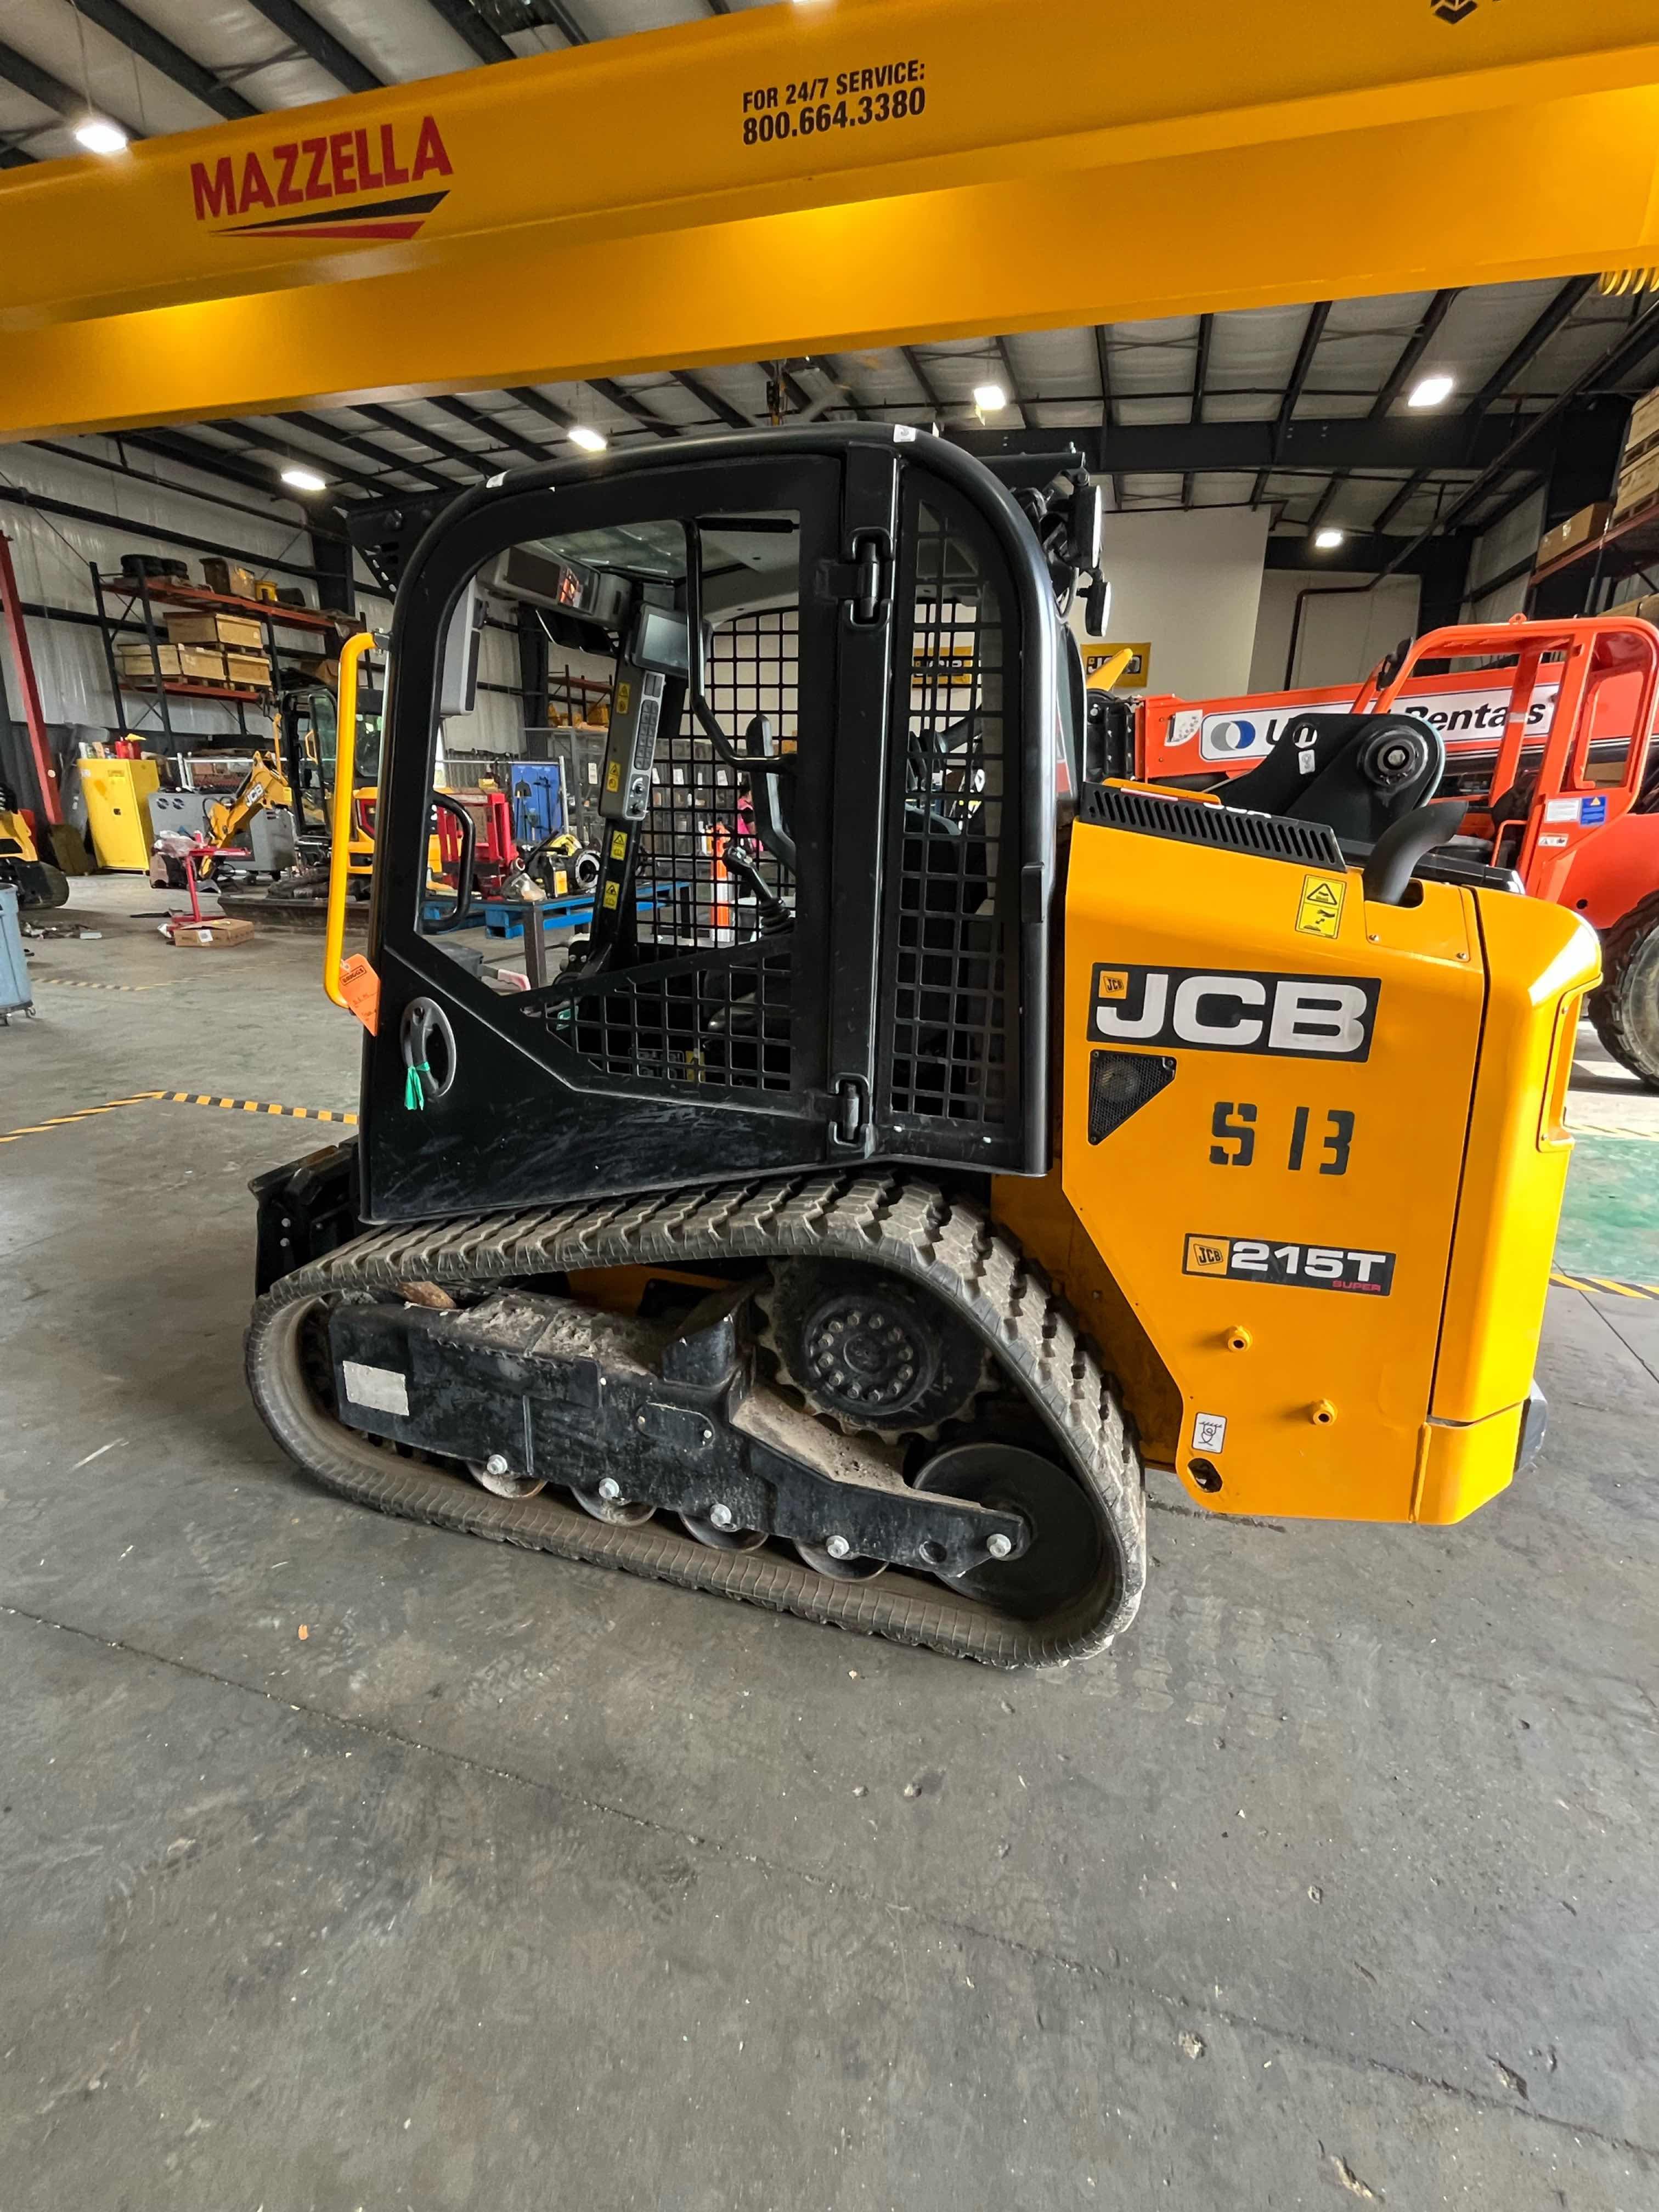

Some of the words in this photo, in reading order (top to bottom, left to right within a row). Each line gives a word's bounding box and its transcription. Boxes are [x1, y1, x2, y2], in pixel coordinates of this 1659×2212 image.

[743, 87, 778, 113] FOR
[786, 77, 828, 105] 24/7
[836, 59, 925, 95] SERVICE:
[743, 86, 926, 145] 800.664.3380
[190, 115, 454, 219] MAZZELLA
[1406, 703, 1545, 730] entas
[246, 783, 263, 807] JCB
[1096, 973, 1368, 1053] JCB
[1209, 1102, 1257, 1167] S
[1288, 1106, 1355, 1175] 13
[1198, 1246, 1223, 1263] JCB
[1231, 1241, 1386, 1282] 215T
[1332, 1280, 1381, 1292] SUPER
